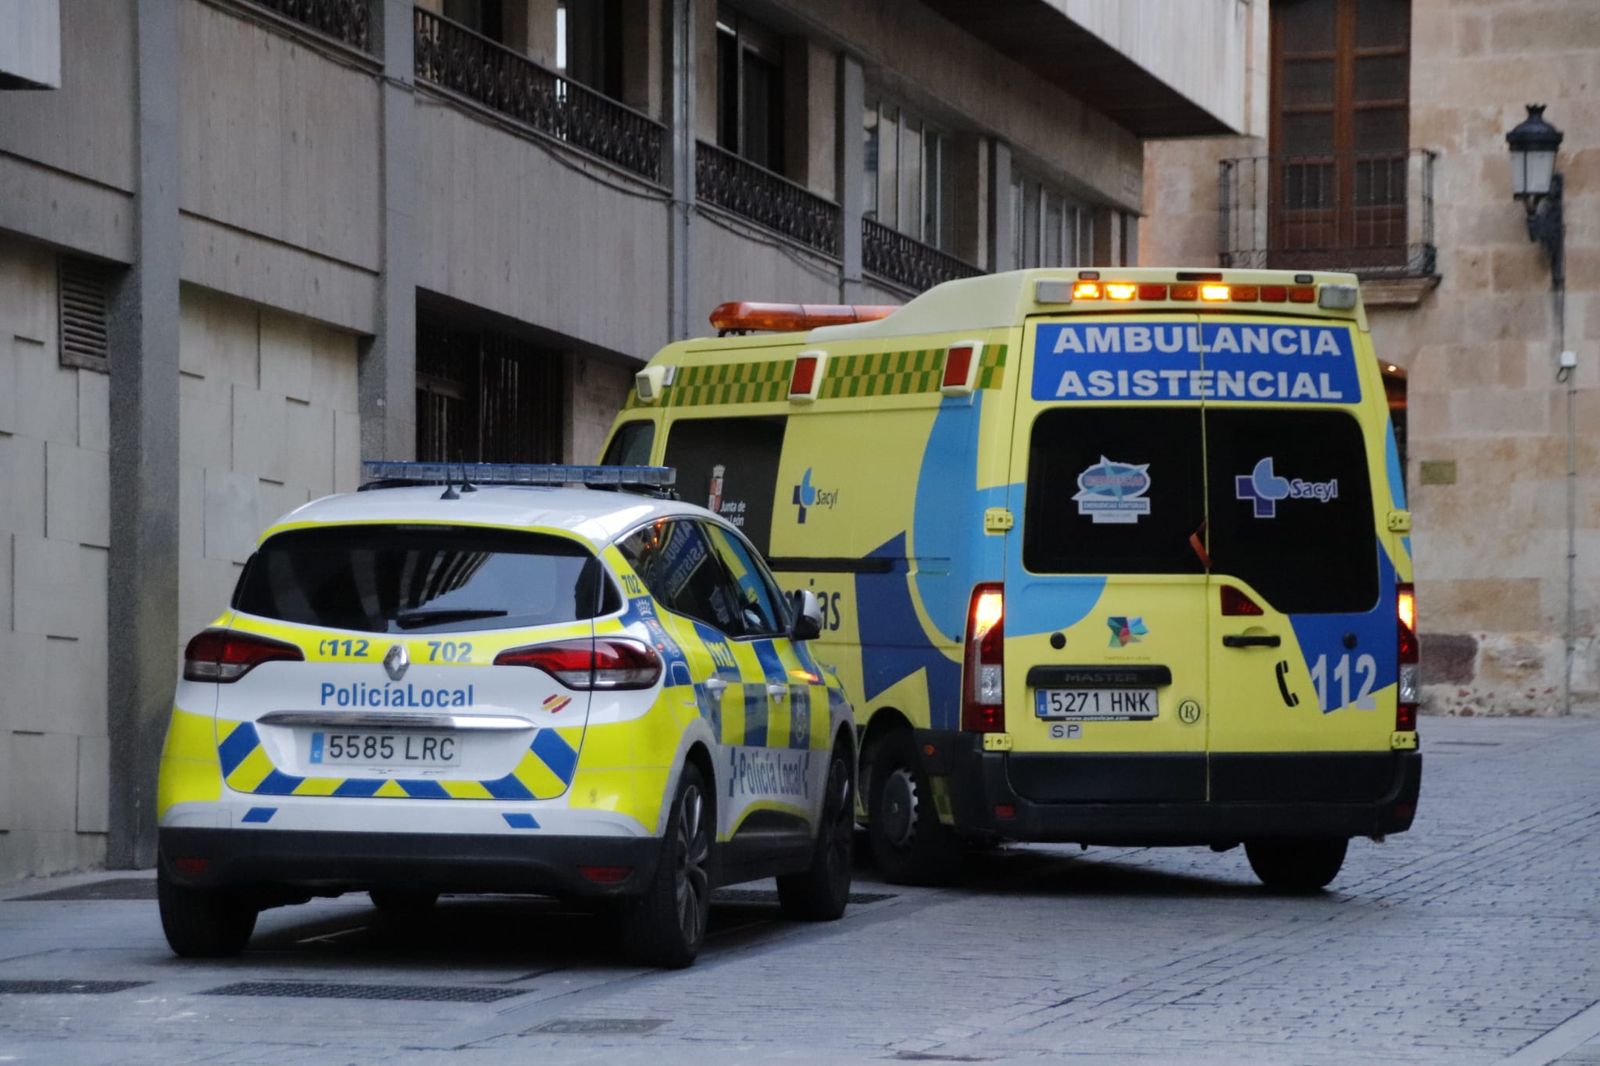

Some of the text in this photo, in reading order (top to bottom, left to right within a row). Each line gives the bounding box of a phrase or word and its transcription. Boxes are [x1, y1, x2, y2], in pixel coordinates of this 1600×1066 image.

[1053, 326, 1341, 356] AMBULANCIA
[1056, 369, 1342, 399] ASISTENCIAL
[815, 488, 839, 509] Sacyl
[1290, 478, 1338, 503] Sacyl
[720, 501, 747, 512] Junta de
[621, 574, 642, 594] 702
[329, 639, 369, 657] 112
[427, 640, 473, 662] 702
[1065, 673, 1138, 682] MASTER
[1311, 653, 1377, 711] 112
[1050, 692, 1151, 712] 5271 HNK
[1052, 725, 1080, 738] SP
[329, 735, 456, 761] 5585 LRC
